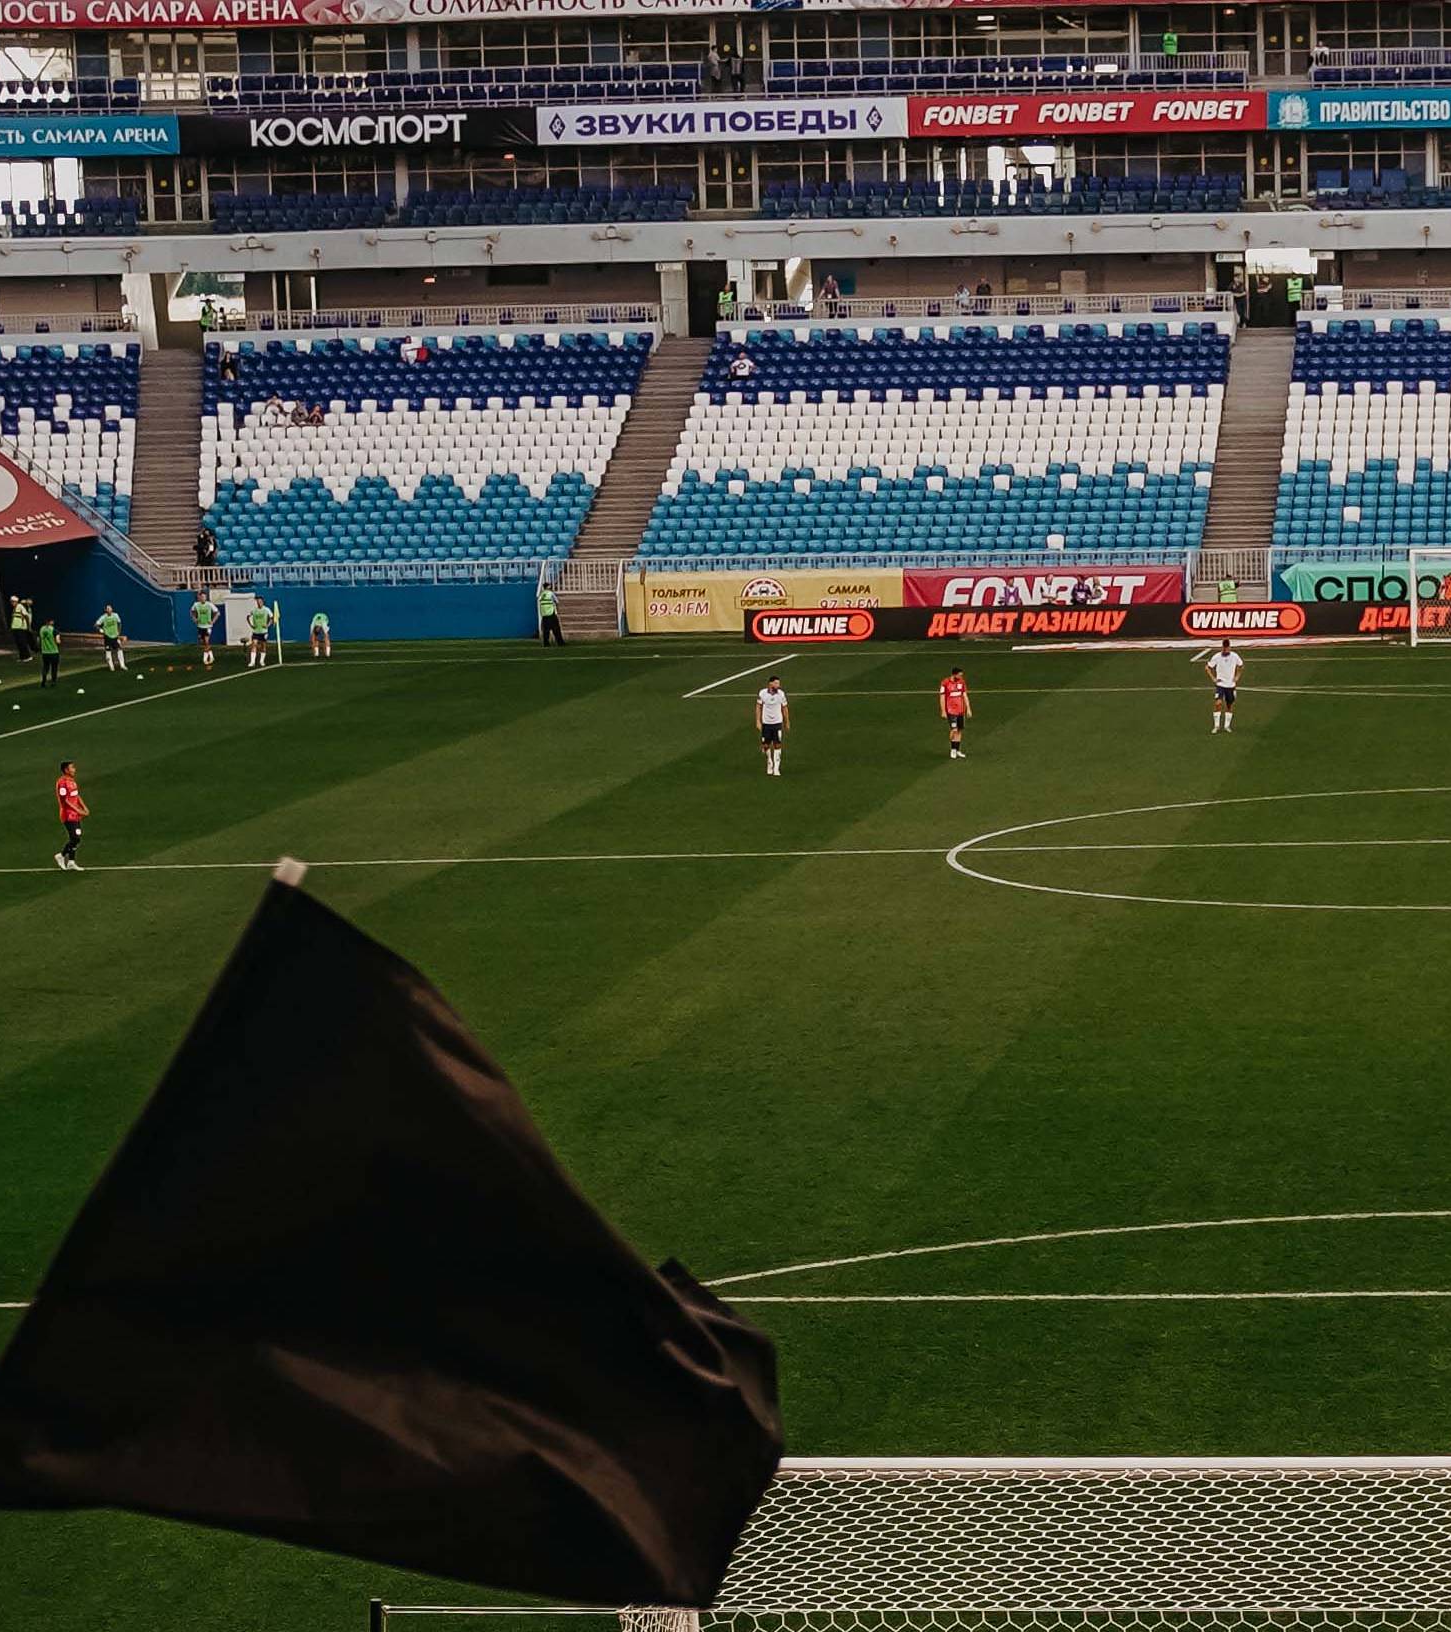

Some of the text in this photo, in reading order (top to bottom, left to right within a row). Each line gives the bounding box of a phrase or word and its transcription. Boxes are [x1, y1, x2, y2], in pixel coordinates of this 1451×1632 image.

[86, 1, 204, 22] САМАРА
[211, 0, 300, 21] АРЕНА
[923, 99, 1250, 126] FONBET FONBET FONBET
[1320, 98, 1451, 124] ПРАВИТЕЛЬСТВО
[575, 109, 857, 138] ЗВУКИ ПОБЕДЫ
[31, 128, 108, 145] САМАРА
[112, 126, 169, 144] АРЕНА
[15, 509, 55, 523] БАНК
[651, 588, 707, 600] ТОЛЬЯТТИ
[827, 584, 871, 597] САМАРА
[648, 601, 710, 617] 99.4 FM
[762, 617, 849, 635] WINLINE
[927, 609, 1128, 638] ДЕЛАЕТ РАЗНИЦУ
[1191, 610, 1279, 628] WINLINE
